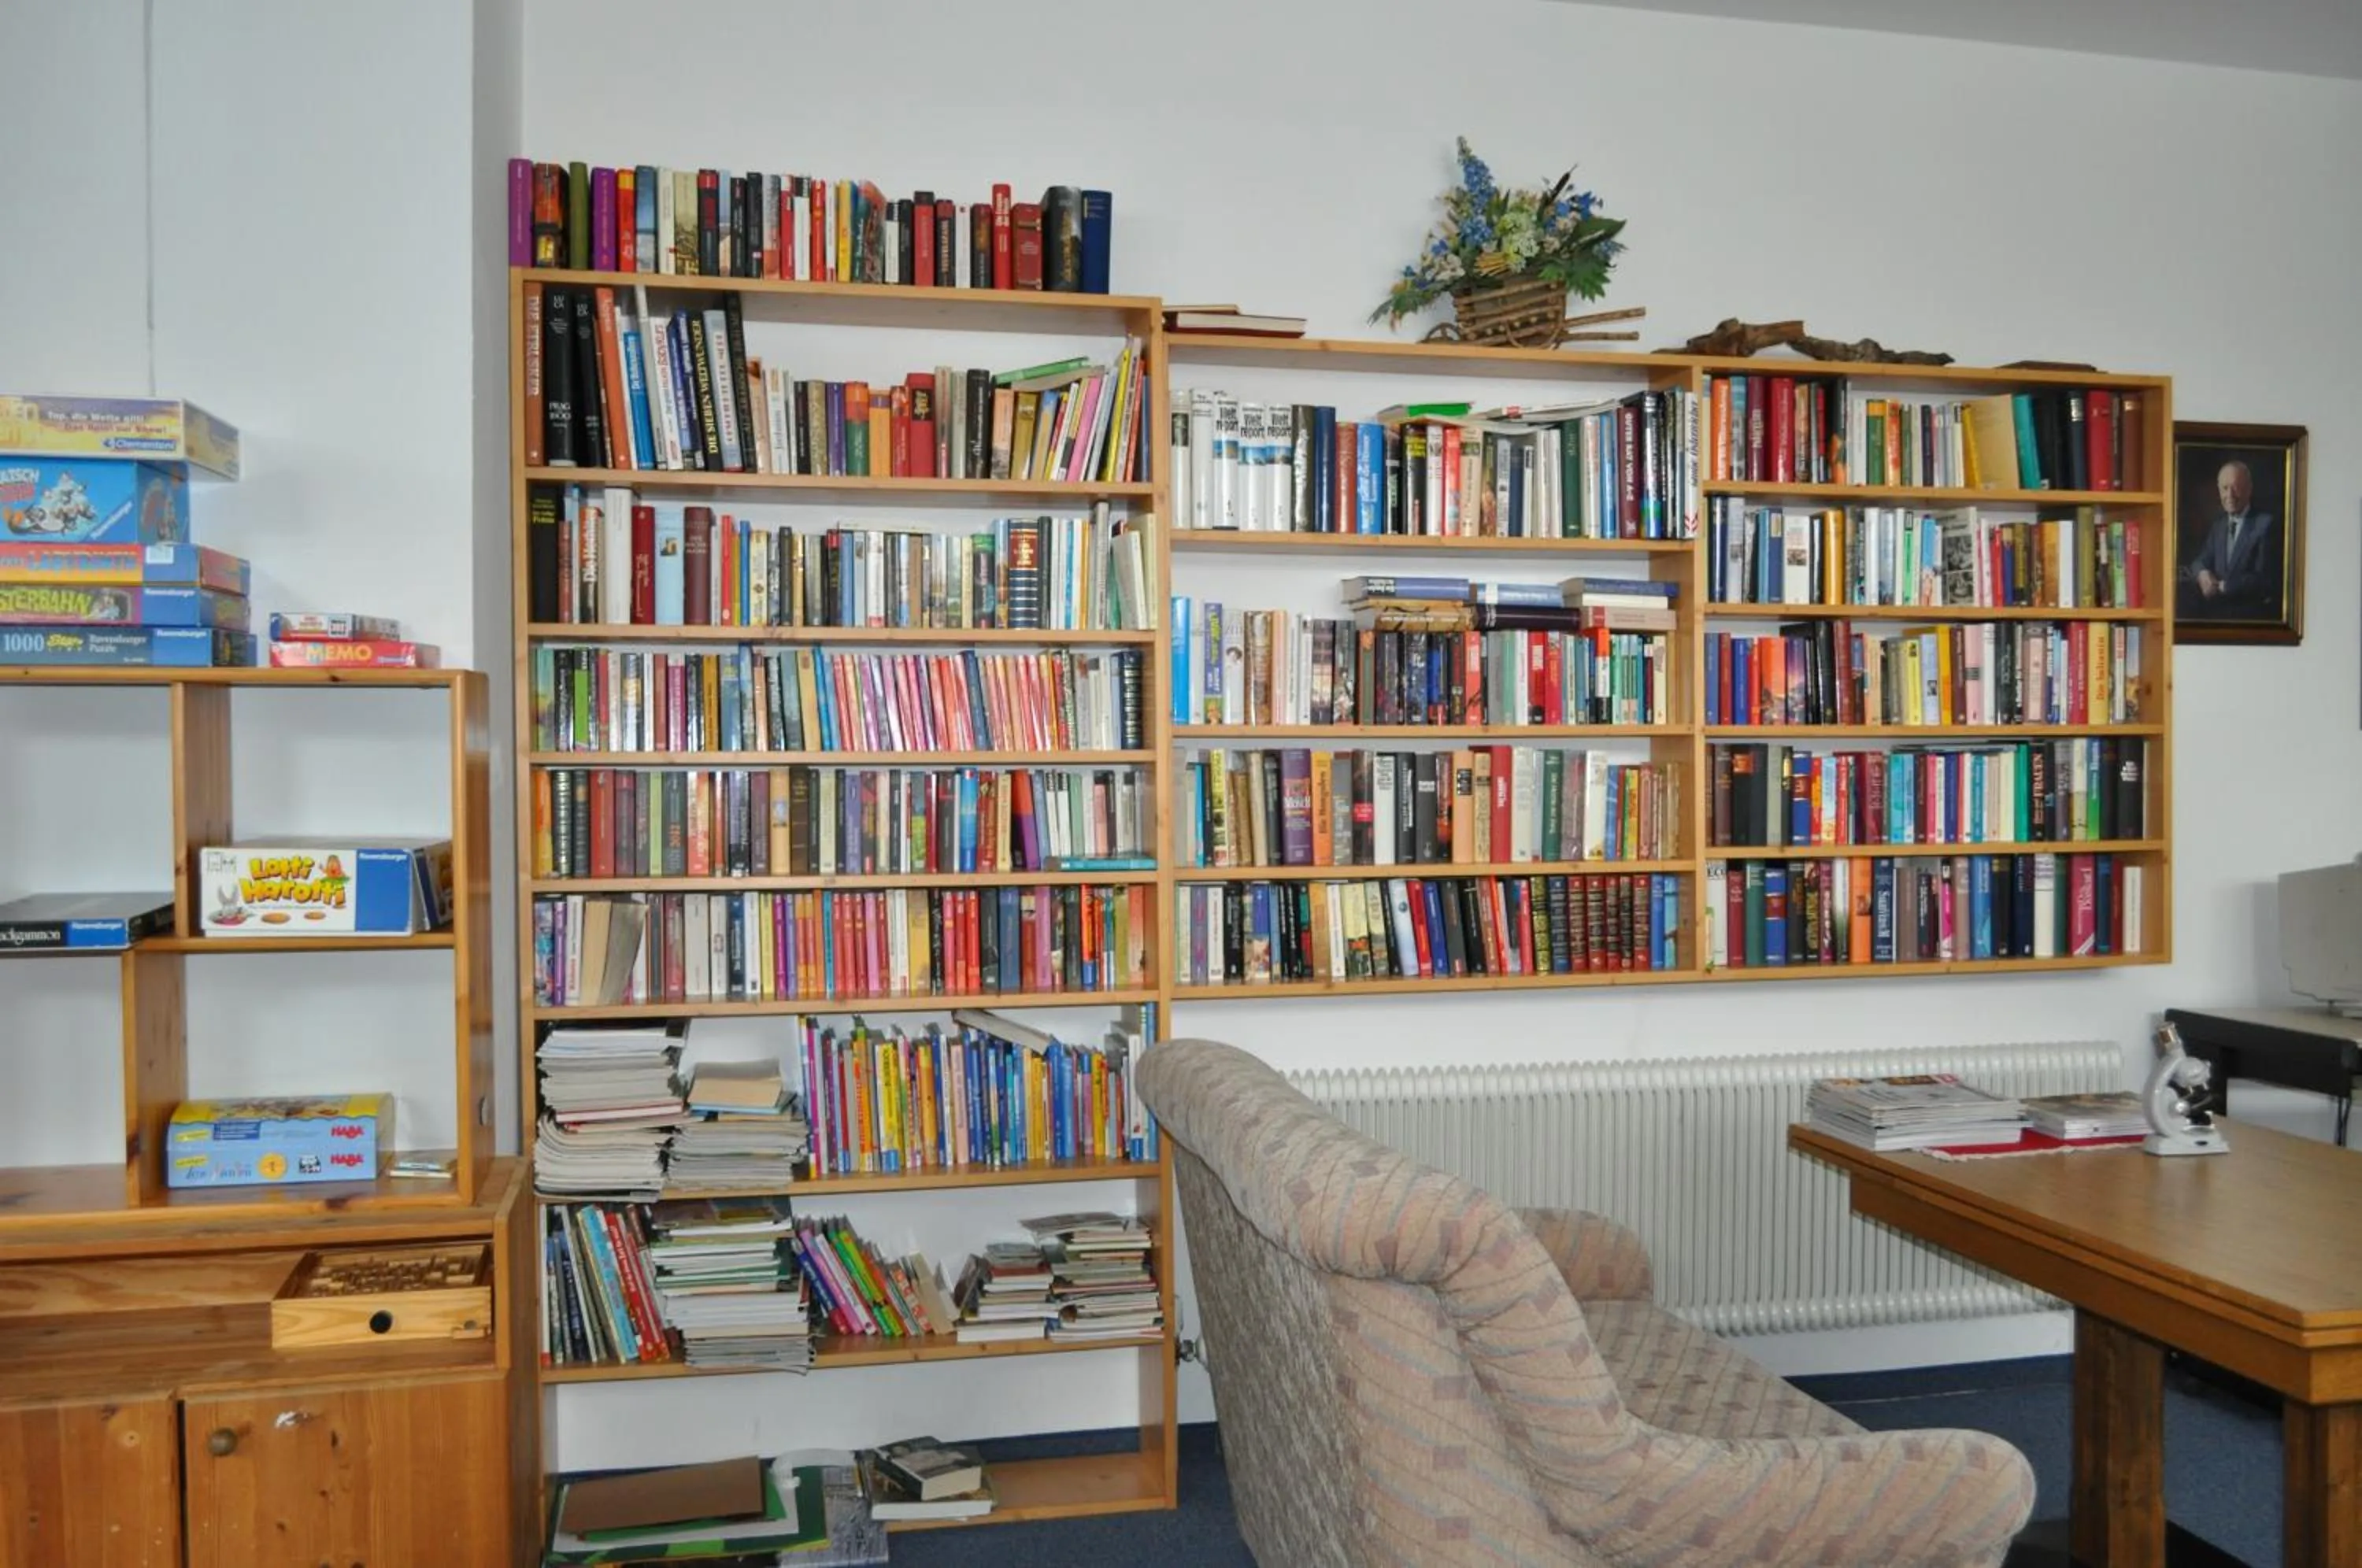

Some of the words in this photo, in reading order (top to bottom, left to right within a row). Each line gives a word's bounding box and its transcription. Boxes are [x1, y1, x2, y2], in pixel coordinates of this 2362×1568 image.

[3, 633, 44, 652] 1000
[306, 643, 372, 664] MEMO
[249, 854, 315, 881] Lotti
